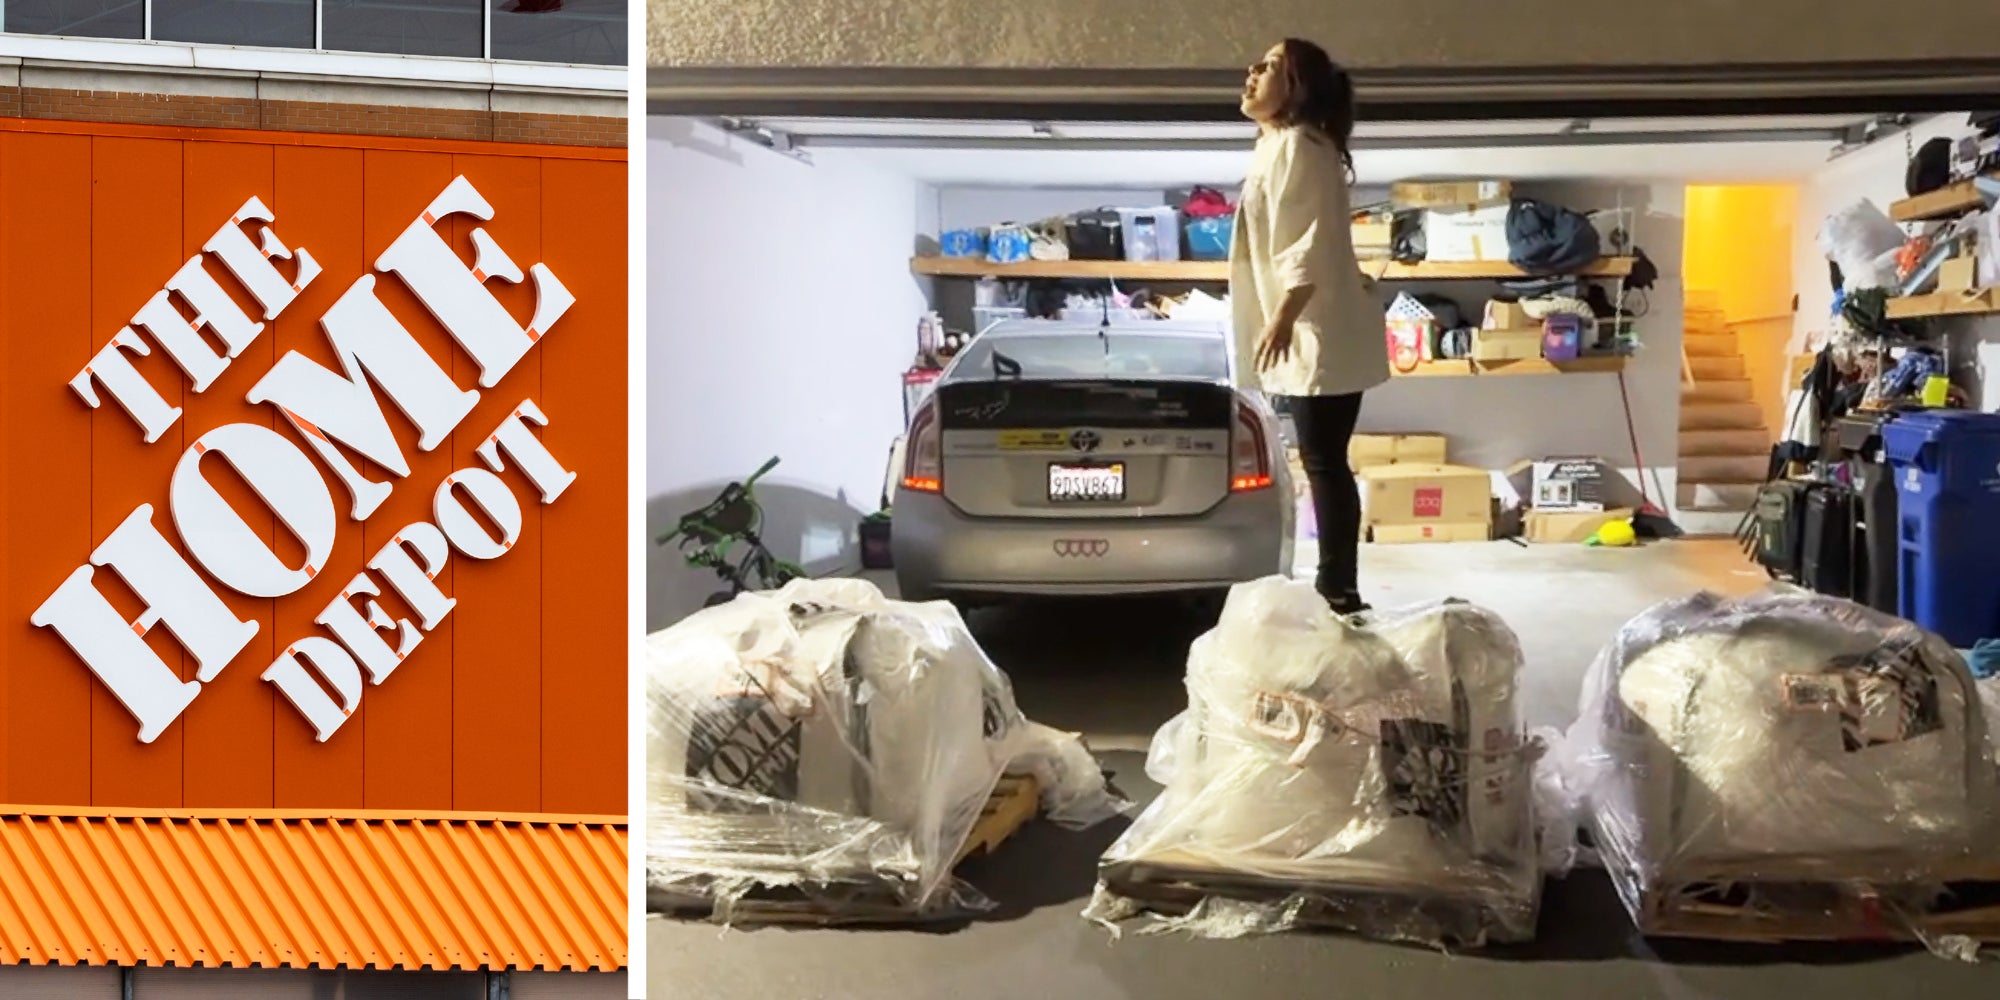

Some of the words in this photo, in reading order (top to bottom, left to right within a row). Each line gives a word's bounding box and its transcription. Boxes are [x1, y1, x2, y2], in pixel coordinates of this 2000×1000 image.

[30, 174, 577, 744] HOME
[68, 195, 323, 443] THE
[260, 398, 577, 743] DEPOT
